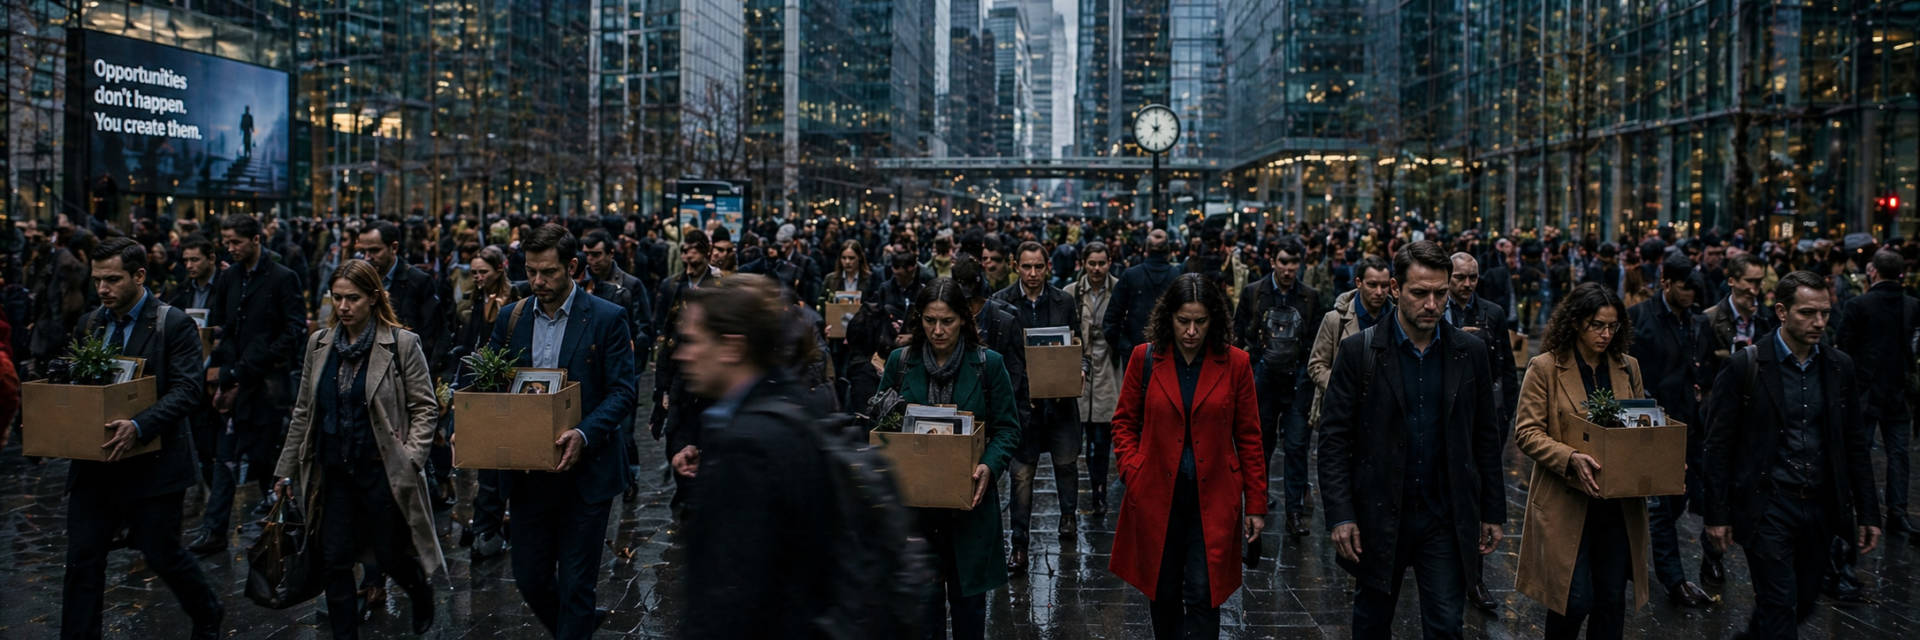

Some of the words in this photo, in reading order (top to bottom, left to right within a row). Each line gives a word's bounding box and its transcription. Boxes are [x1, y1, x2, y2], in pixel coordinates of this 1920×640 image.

[94, 58, 188, 89] Opportunities
[94, 85, 133, 107] don't
[134, 89, 187, 115] happen.
[94, 112, 122, 132] You
[123, 119, 166, 136] create
[167, 119, 203, 140] them.
